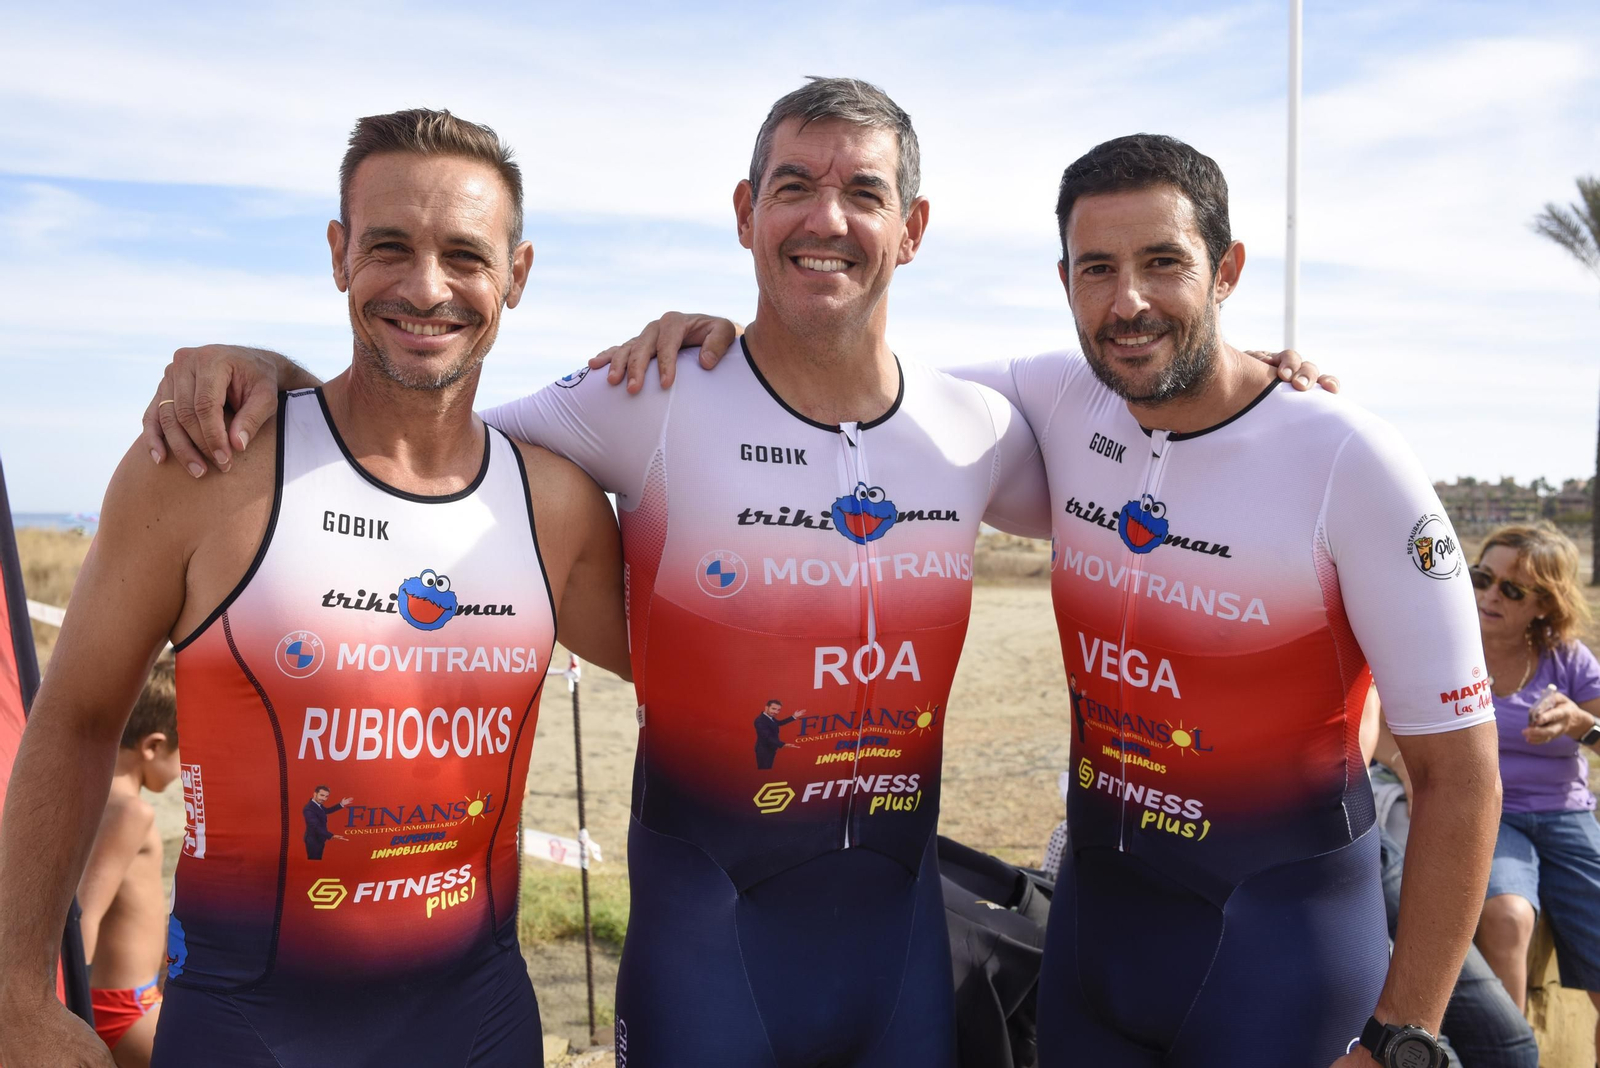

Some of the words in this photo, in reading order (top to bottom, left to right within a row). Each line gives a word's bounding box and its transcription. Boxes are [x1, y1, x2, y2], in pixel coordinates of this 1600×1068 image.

[740, 443, 808, 466] GOBIK
[1089, 432, 1127, 464] GOBIK
[323, 510, 390, 541] GOBIK
[737, 506, 834, 531] triki
[896, 509, 960, 523] man
[1065, 497, 1119, 532] triki
[1164, 532, 1232, 559] man
[1407, 514, 1429, 555] RESTAURANTE
[702, 552, 739, 566] BMW
[1063, 546, 1270, 625] MOVITRANSA
[321, 589, 398, 614] triki
[455, 603, 516, 616] man
[284, 633, 320, 647] BMW
[336, 643, 537, 673] MOVITRANSA
[813, 640, 921, 689] ROA
[1078, 631, 1181, 699] VEGA
[1454, 702, 1473, 716] Las
[298, 706, 512, 762] RUBIOCOKS
[795, 730, 851, 743] CONSULTING
[193, 766, 204, 824] ELECTRIC
[801, 773, 921, 803] FITNESS
[1097, 771, 1204, 820] FITNESS
[344, 826, 402, 835] CONSULTING
[402, 821, 458, 831] INMOBILIARIO
[390, 831, 446, 846] EXPERTOS
[370, 840, 459, 860] INMOBILIARIOS
[353, 864, 472, 903] FITNESS
